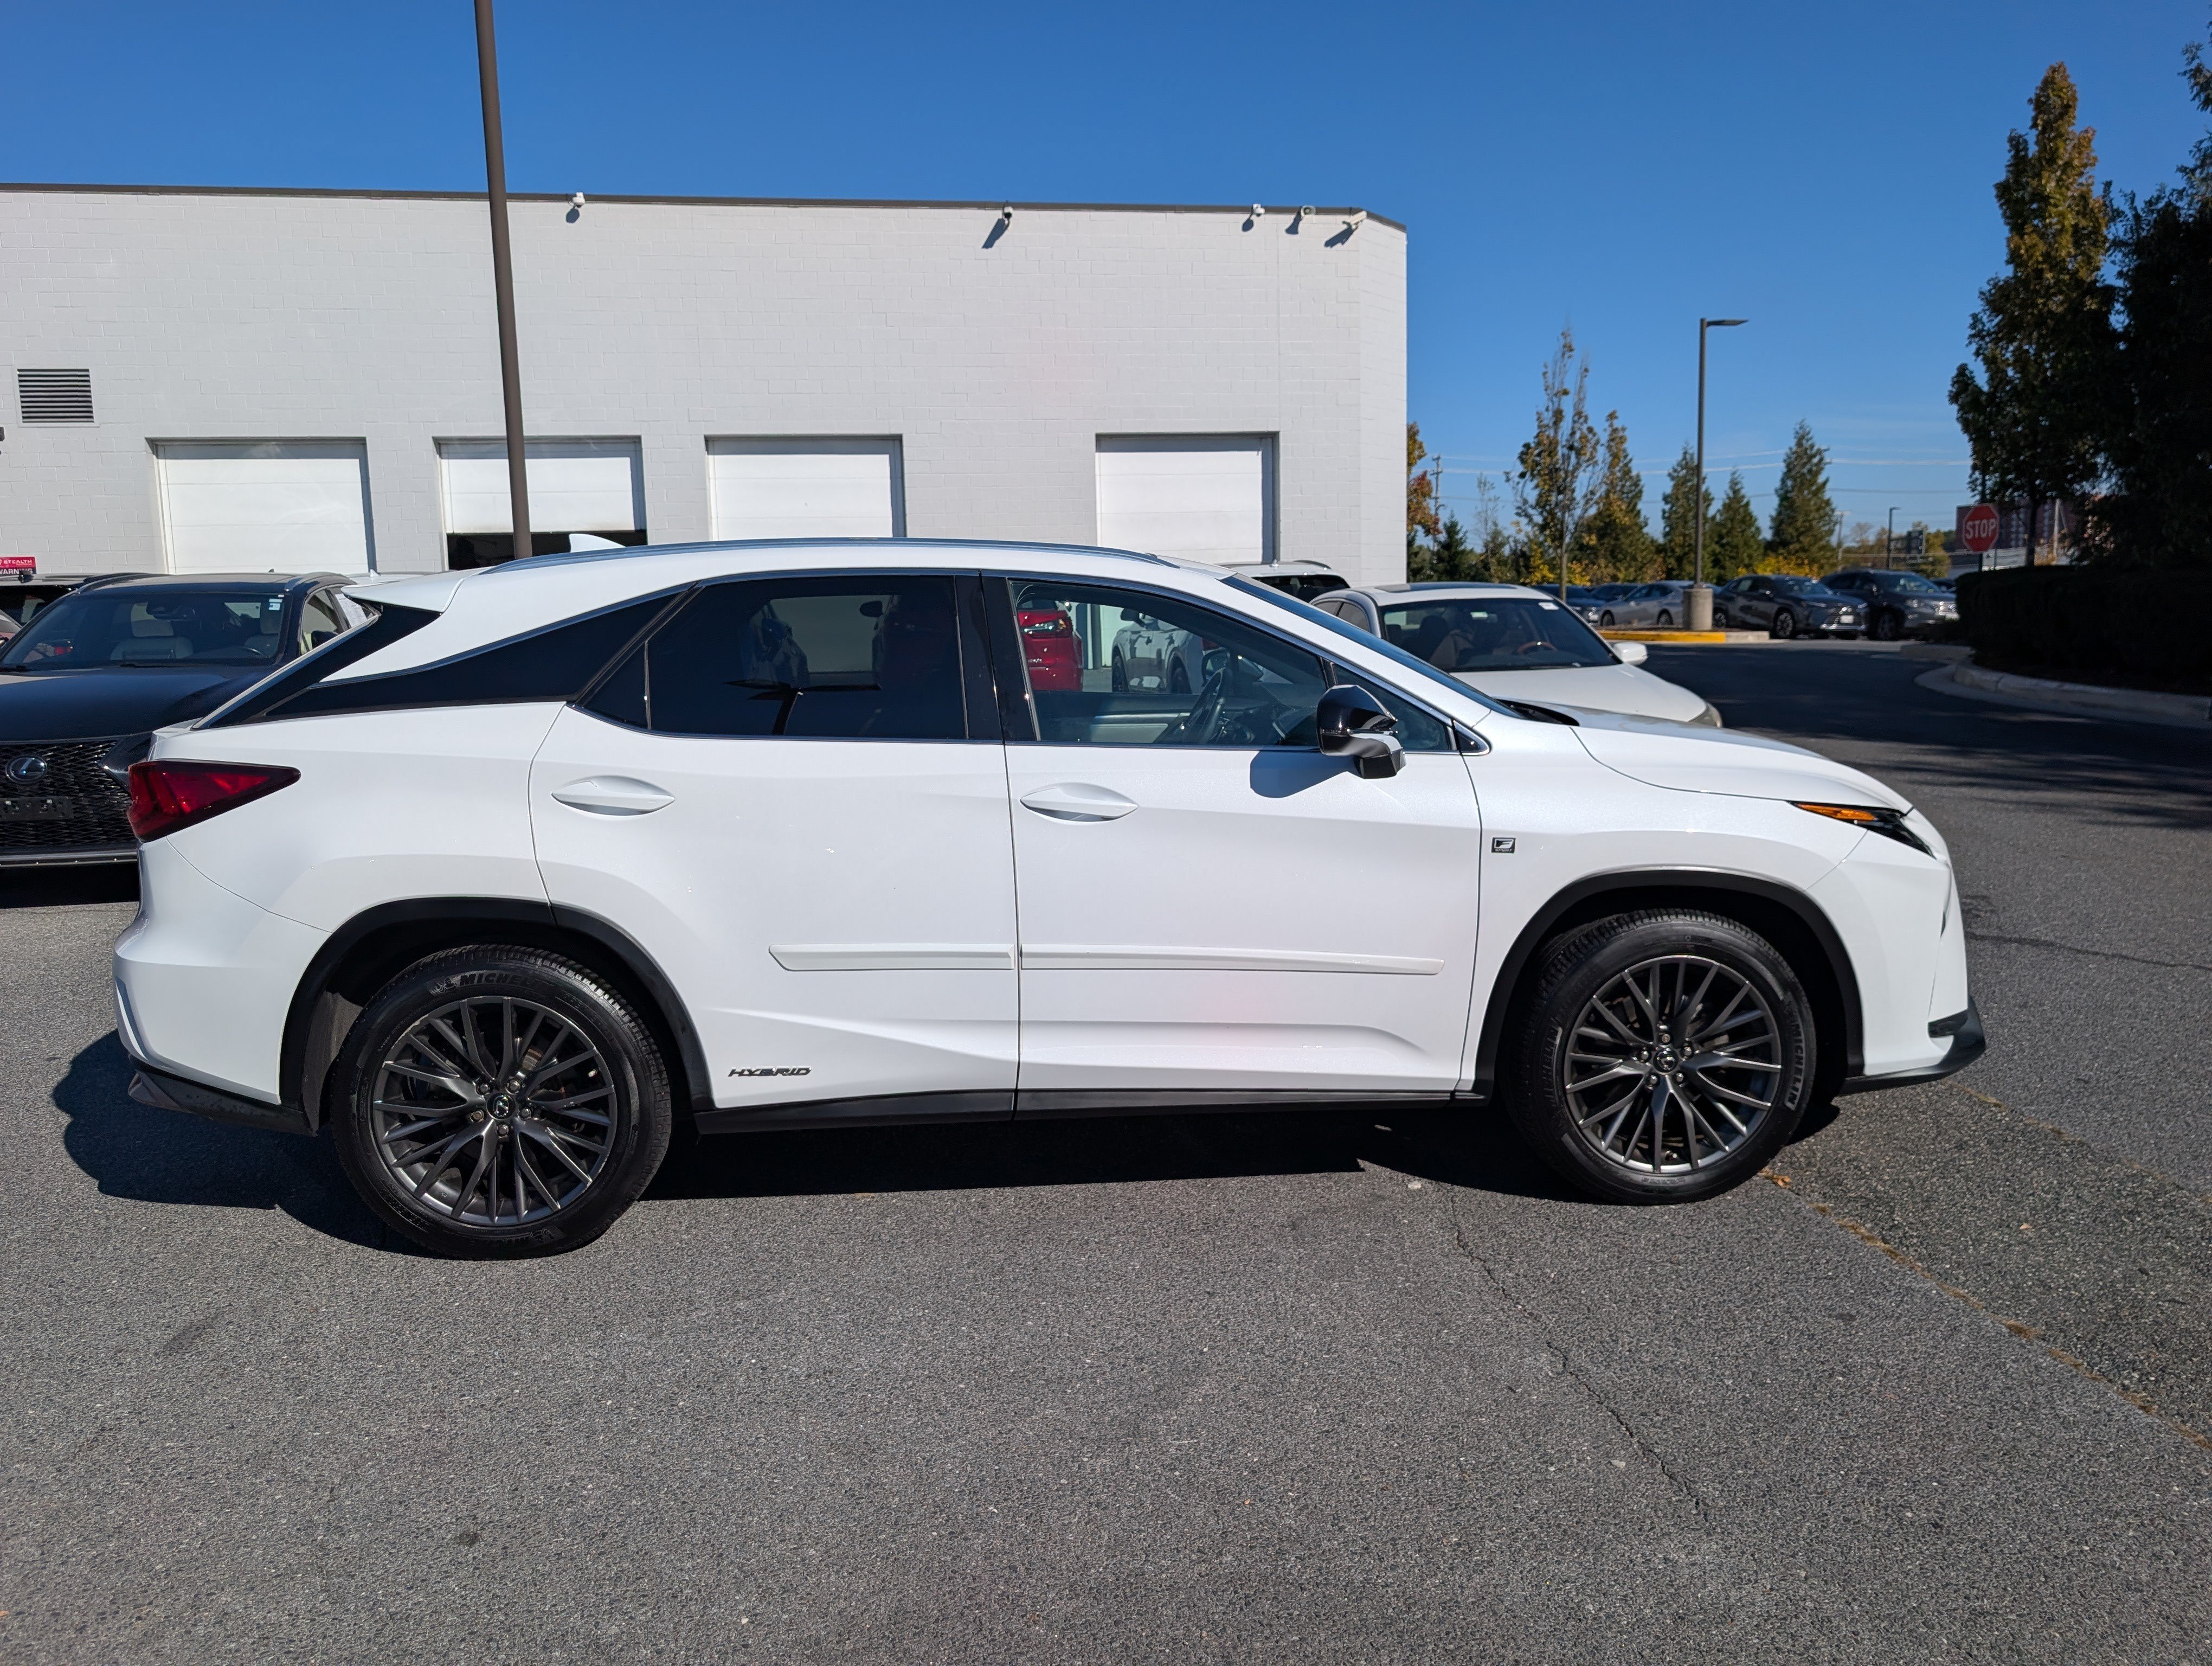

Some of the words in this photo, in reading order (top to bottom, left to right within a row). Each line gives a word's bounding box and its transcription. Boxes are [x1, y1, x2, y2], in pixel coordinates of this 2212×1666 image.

[1966, 518, 1996, 539] STOP
[728, 1067, 812, 1077] HYBRID
[1789, 1023, 1804, 1106] MICHELIN
